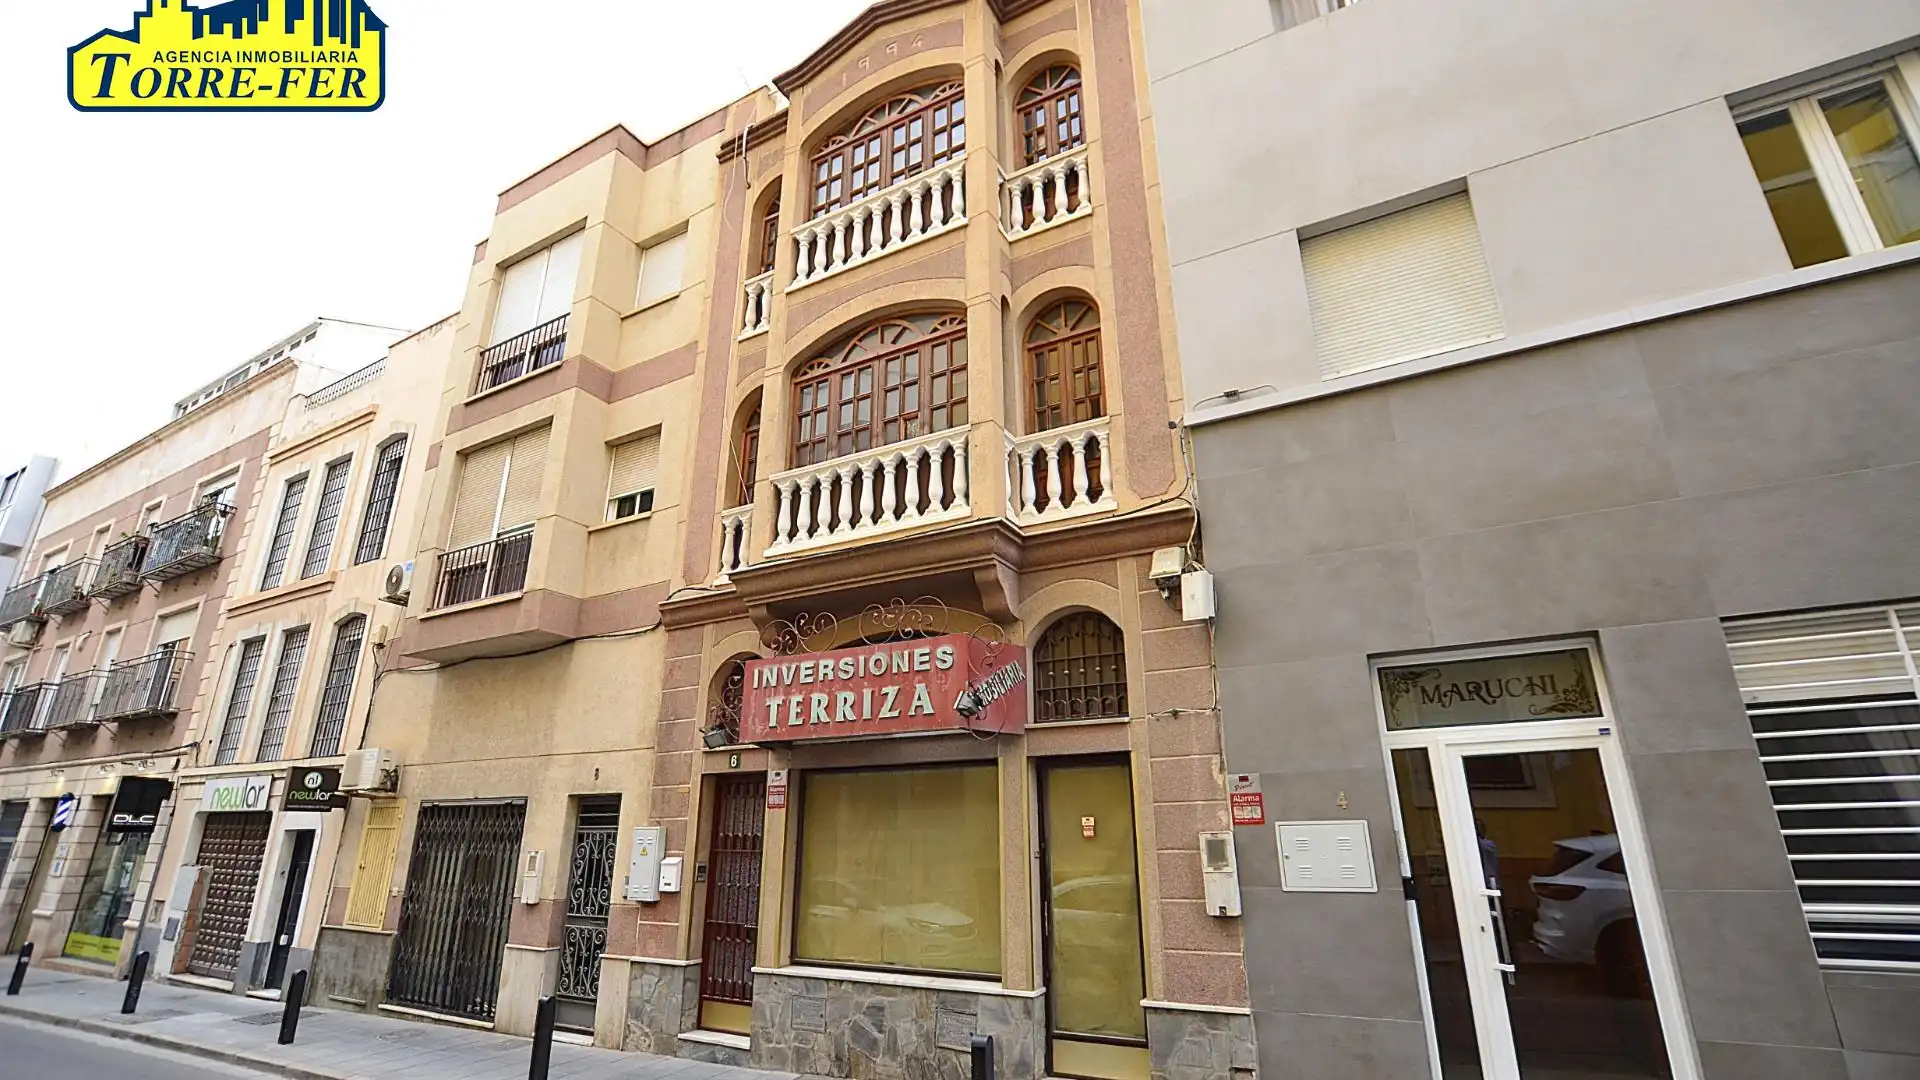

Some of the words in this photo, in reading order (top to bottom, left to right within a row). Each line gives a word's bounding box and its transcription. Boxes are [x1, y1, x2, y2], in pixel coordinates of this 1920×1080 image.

[841, 34, 924, 87] 1994
[753, 646, 955, 689] INVERSIONES
[765, 683, 936, 728] TERRIZA
[1418, 674, 1558, 707] MARUCHI
[731, 754, 737, 767] 6
[209, 778, 265, 810] newlar
[289, 789, 333, 801] newlar
[1337, 791, 1348, 809] 4
[113, 814, 156, 823] DLC
